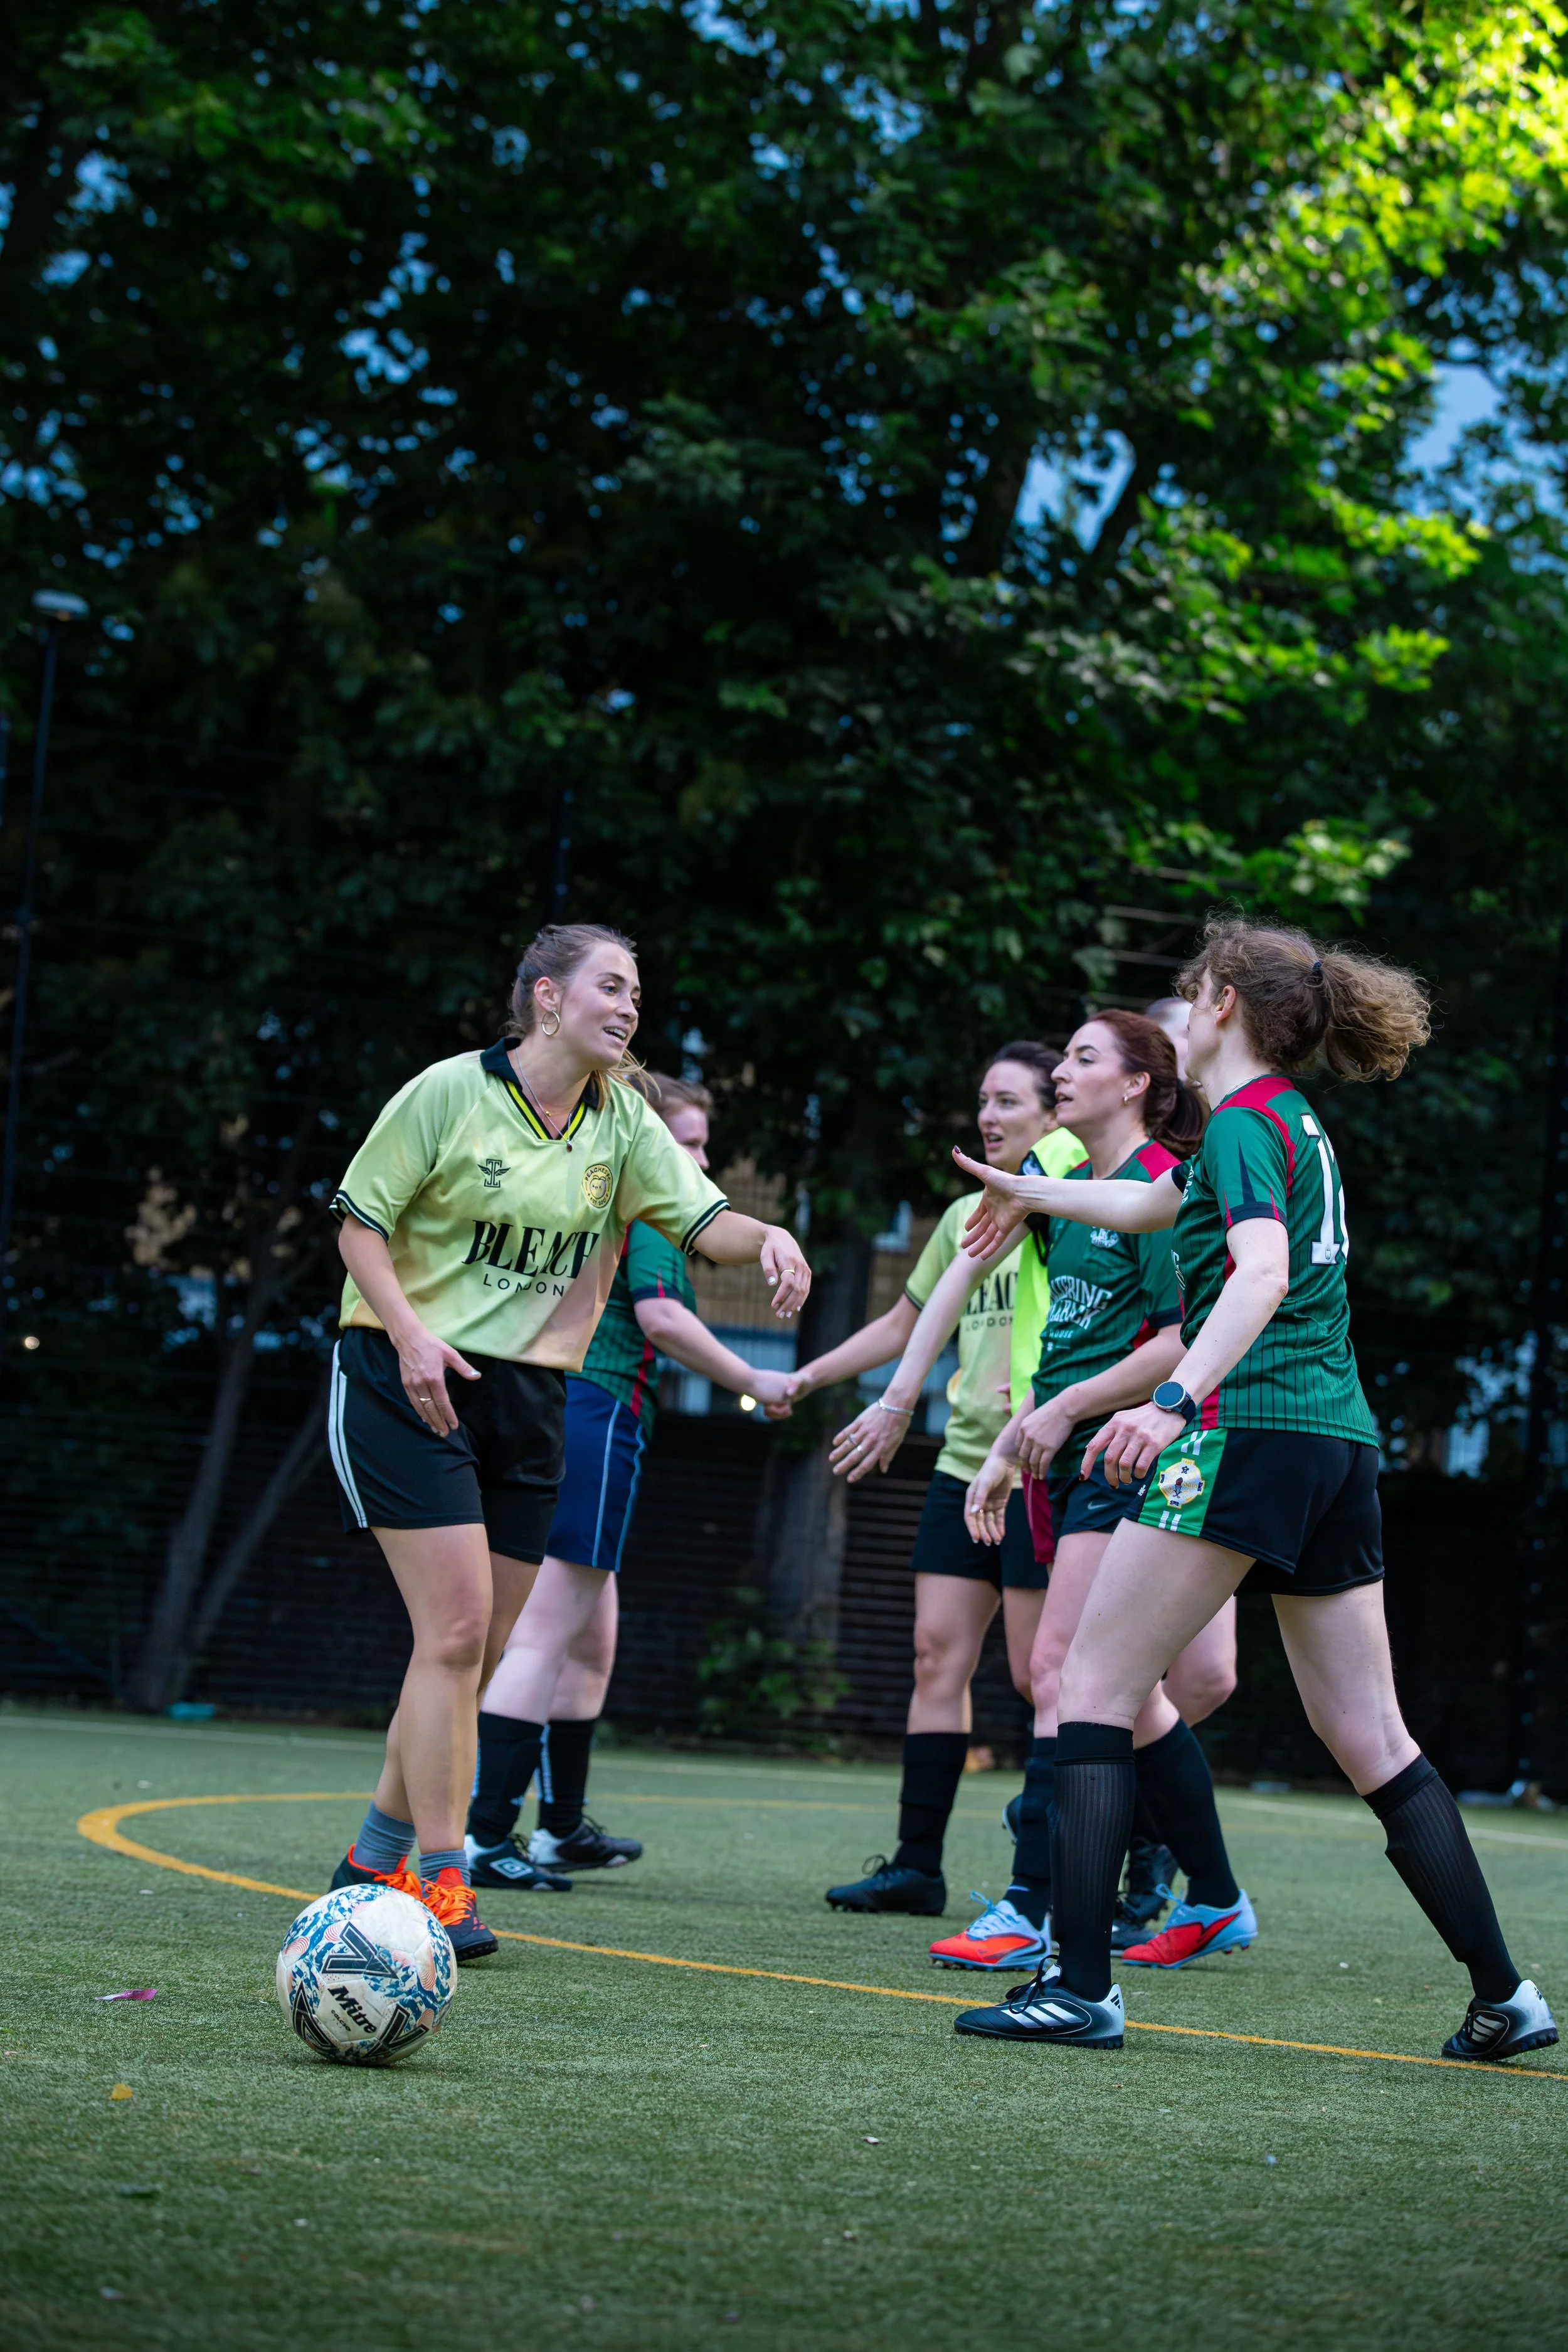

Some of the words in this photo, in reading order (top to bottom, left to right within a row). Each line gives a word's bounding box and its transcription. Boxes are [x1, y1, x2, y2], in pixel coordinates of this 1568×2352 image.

[585, 1167, 608, 1181] PEACHES
[1300, 1113, 1349, 1265] 1
[327, 1985, 377, 2033] Mitre
